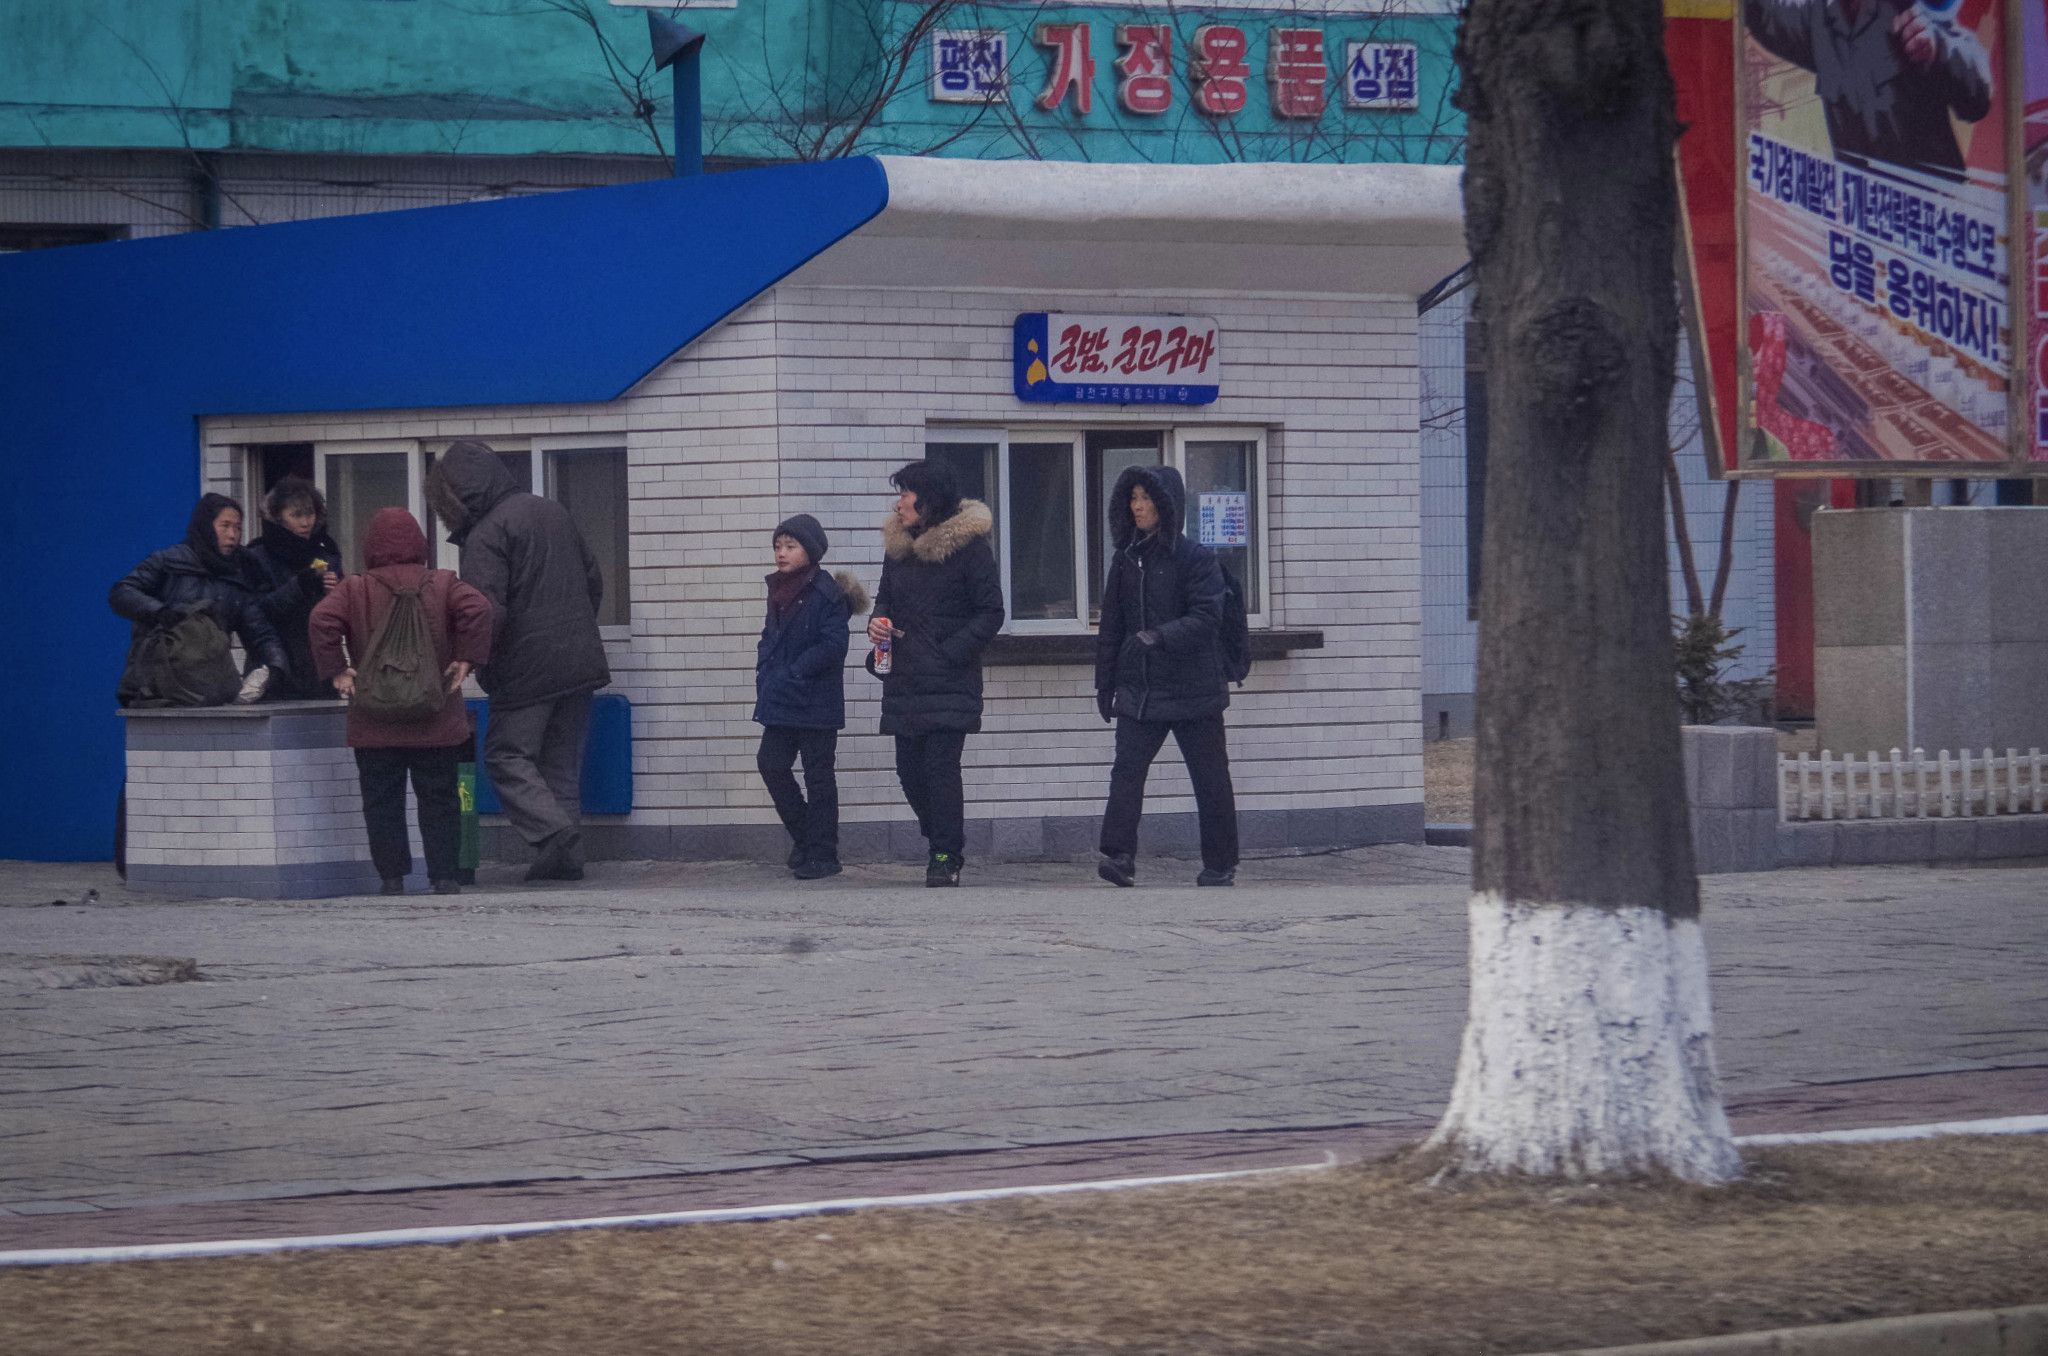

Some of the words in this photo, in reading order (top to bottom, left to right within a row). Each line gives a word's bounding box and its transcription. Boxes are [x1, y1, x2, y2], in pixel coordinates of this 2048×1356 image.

[1034, 23, 1326, 115] 가정용품
[1353, 48, 1415, 99] 상점
[1751, 134, 1836, 220] 국가경제발전
[1829, 230, 1875, 303] 당을
[1887, 259, 1998, 362] 옹위하자!
[1111, 325, 1215, 375] 군고구마
